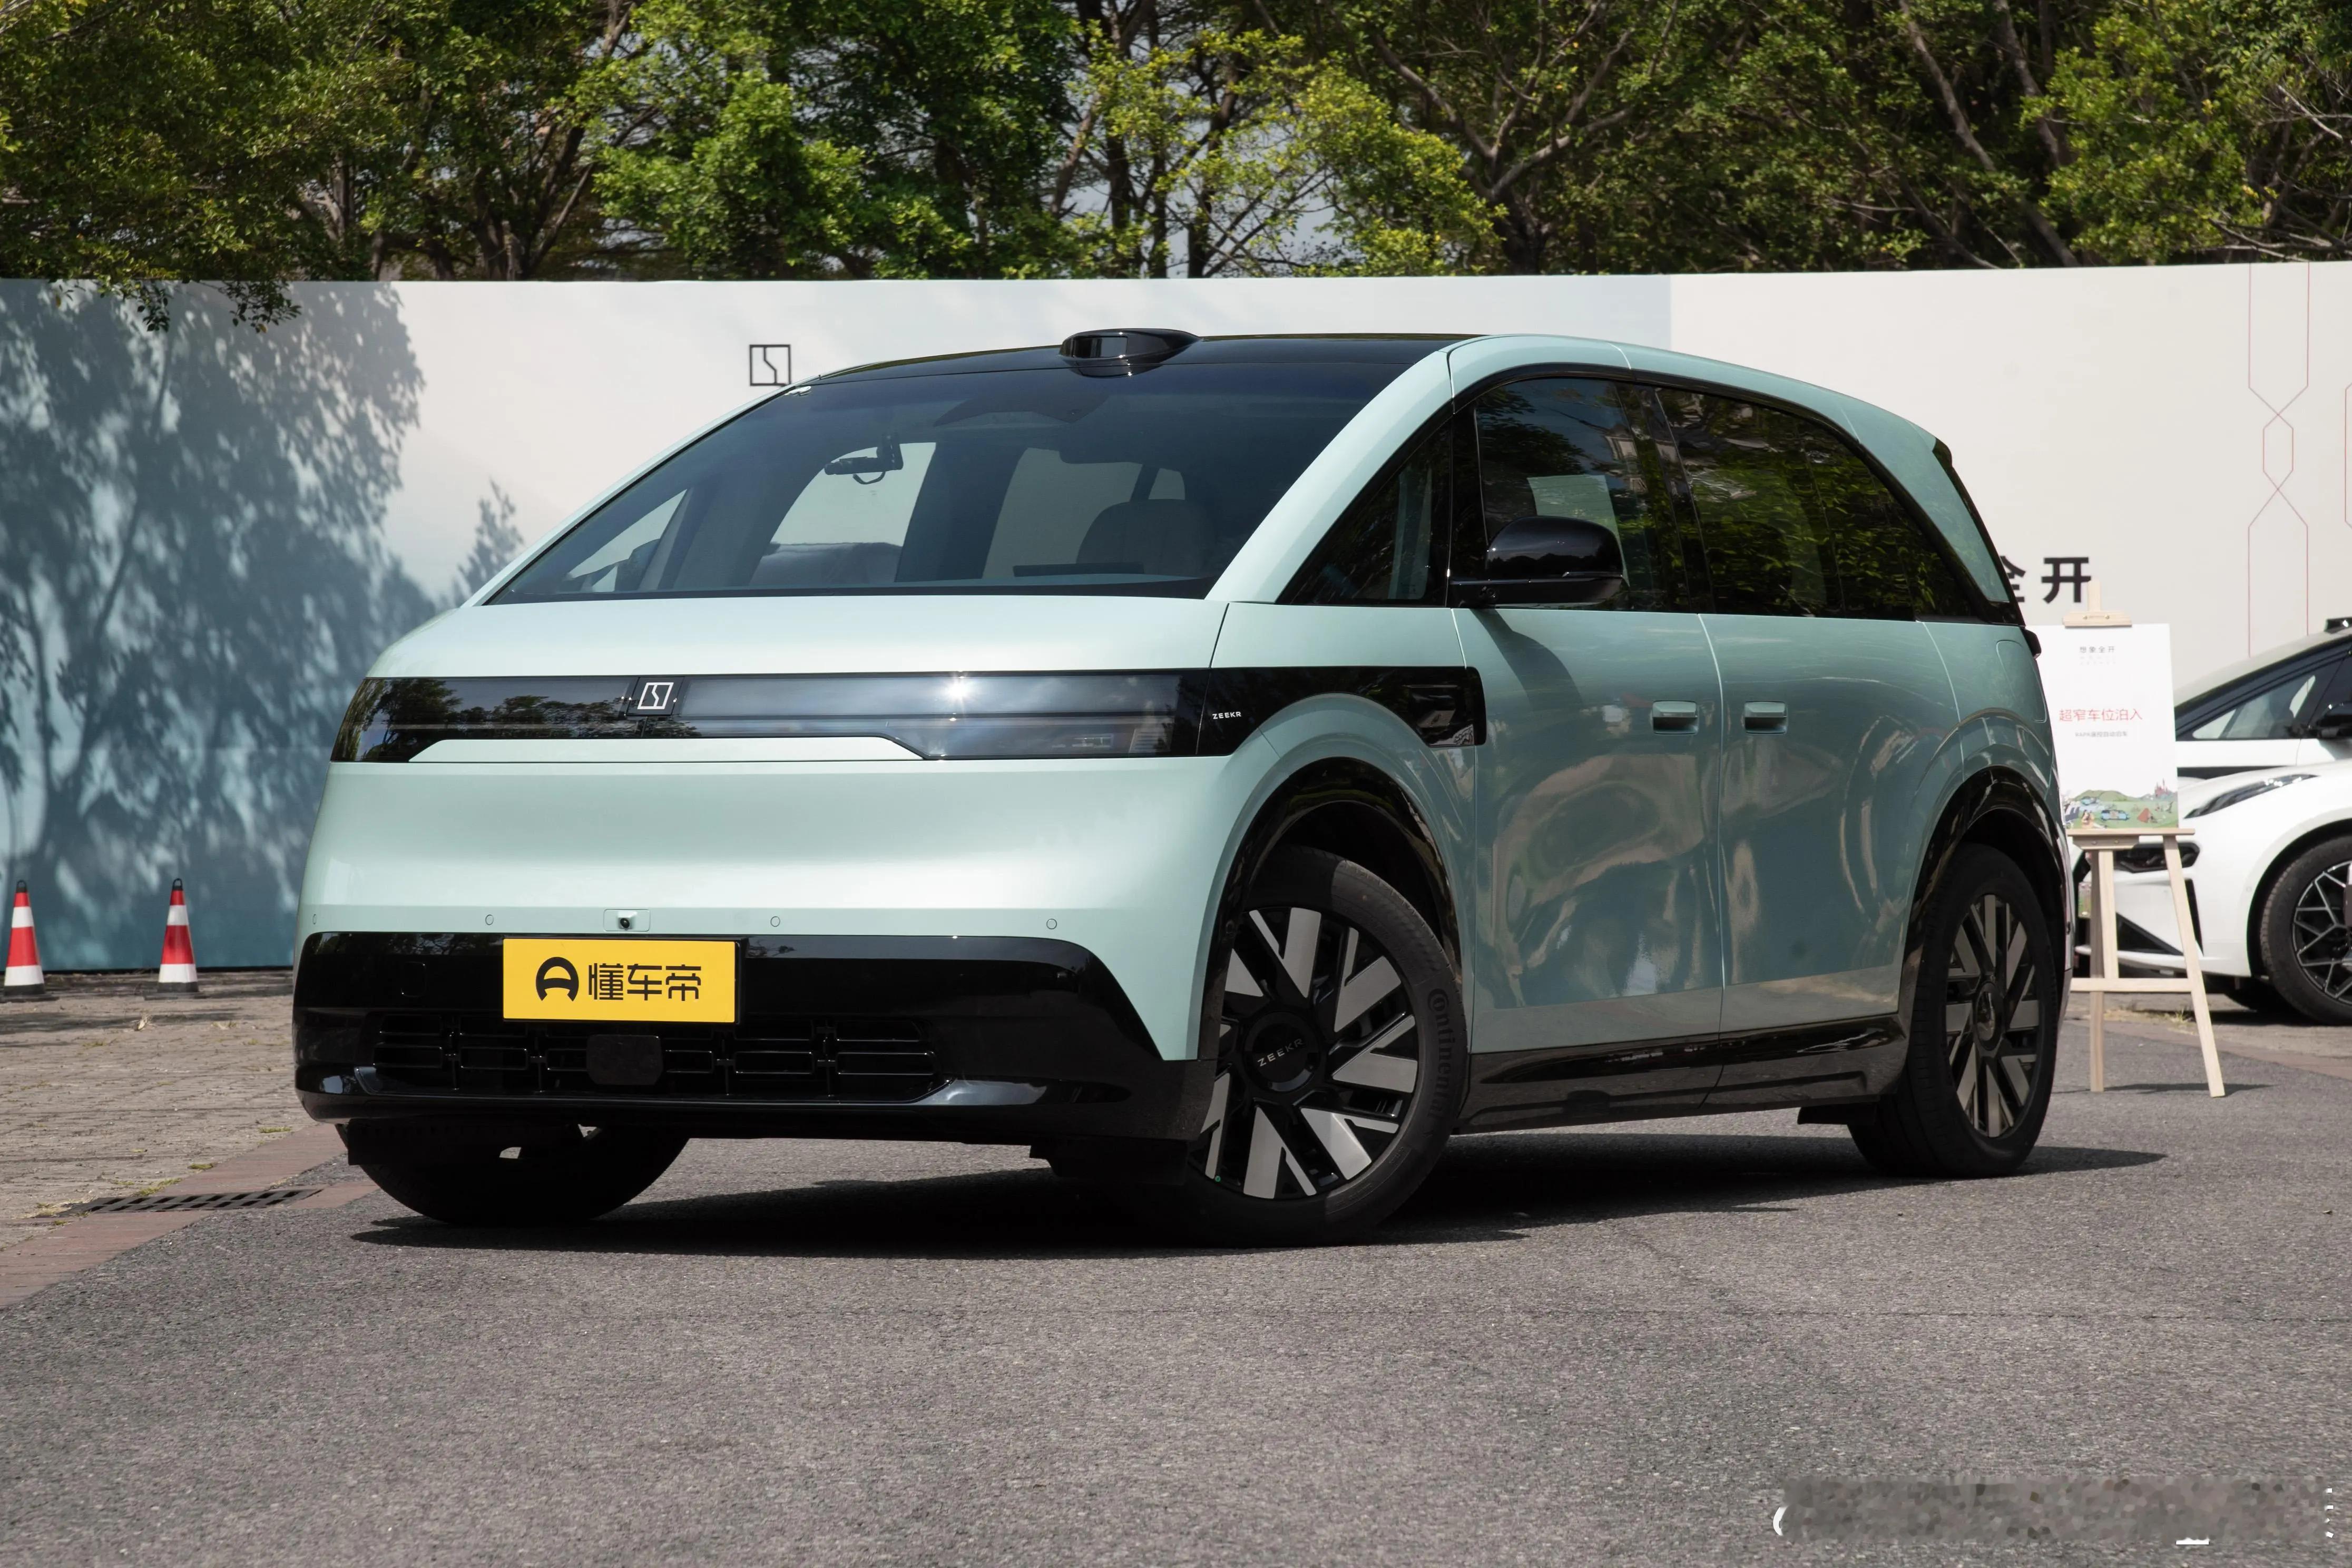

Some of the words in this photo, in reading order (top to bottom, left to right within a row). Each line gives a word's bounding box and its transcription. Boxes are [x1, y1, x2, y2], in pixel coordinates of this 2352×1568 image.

[1212, 711, 1242, 720] ZEEKR
[2059, 708, 2142, 722] 超窄车位泊入
[588, 963, 702, 1002] 懂车帝
[1257, 1038, 1303, 1067] ZEEKR
[1427, 988, 1455, 1118] Continental
